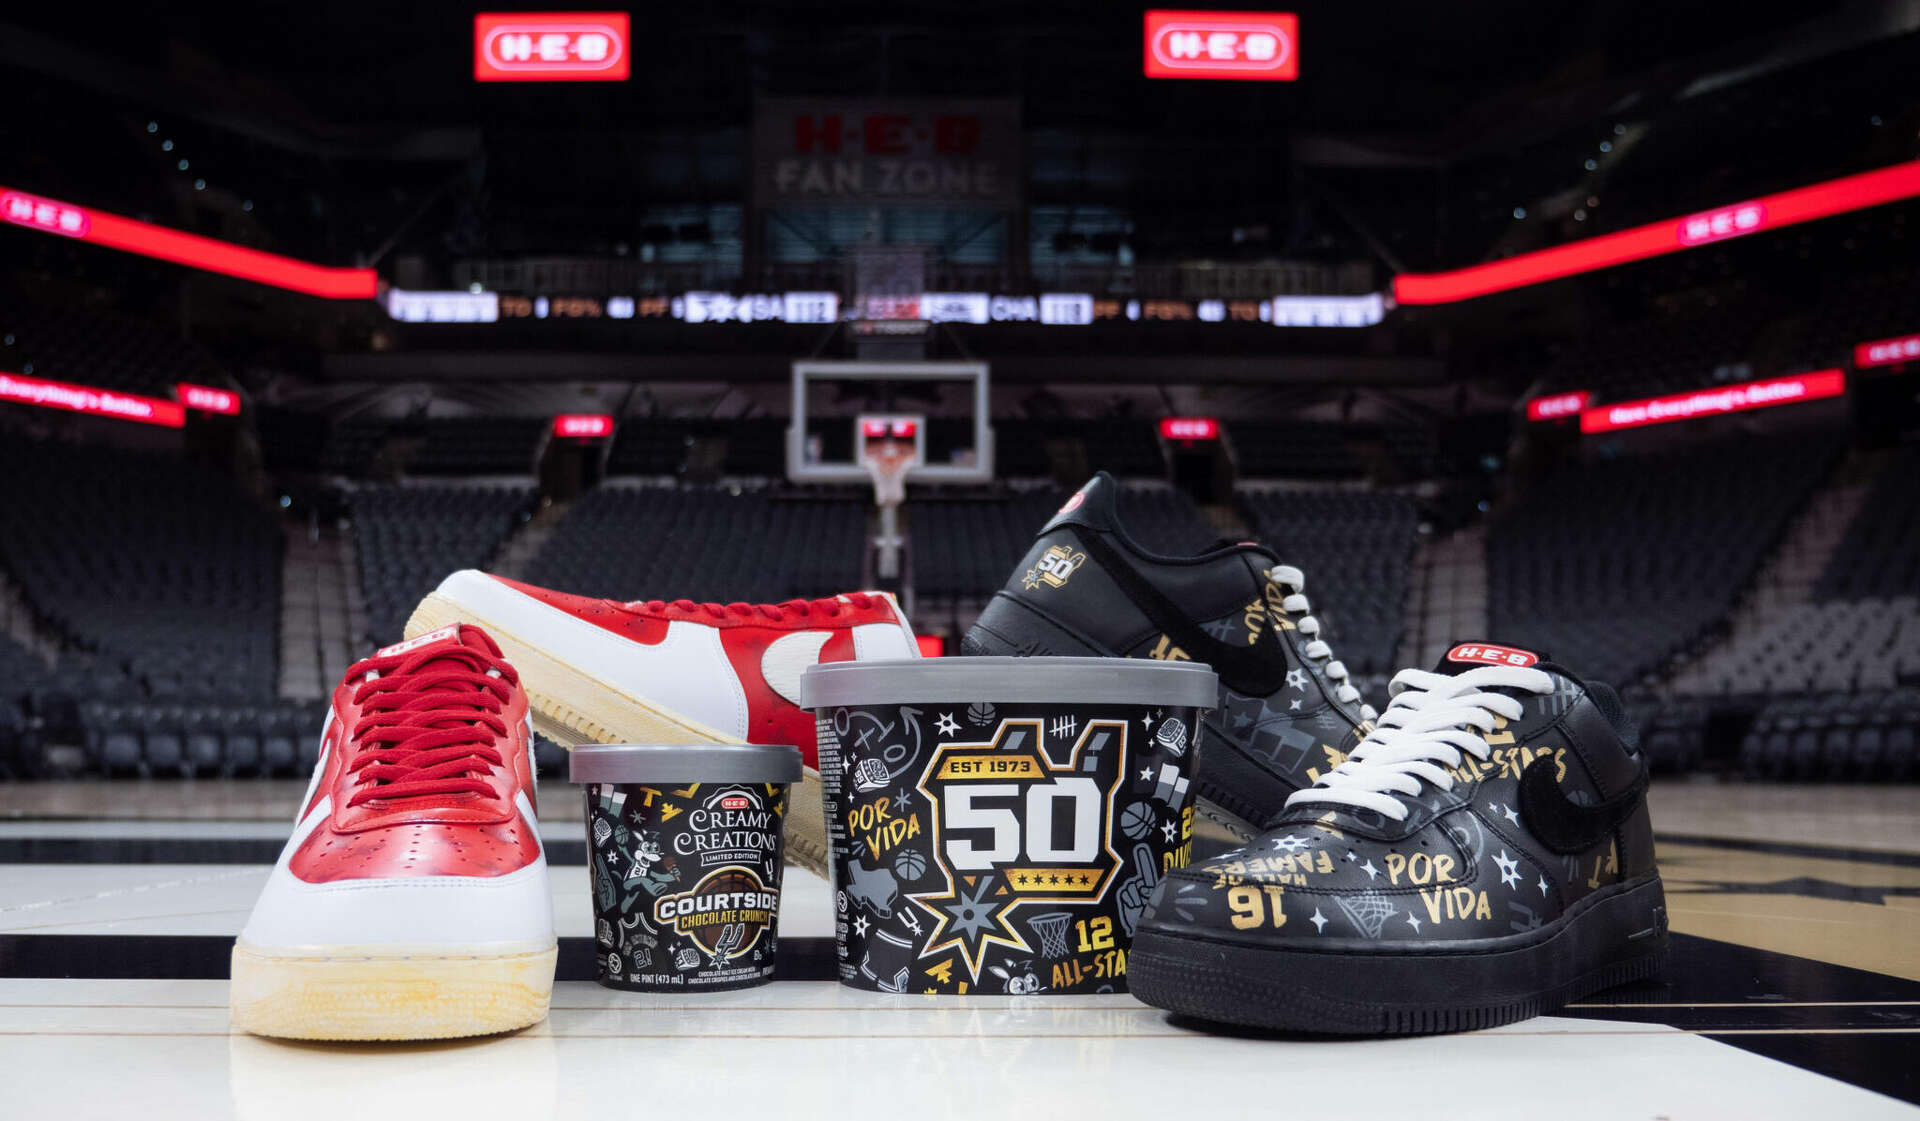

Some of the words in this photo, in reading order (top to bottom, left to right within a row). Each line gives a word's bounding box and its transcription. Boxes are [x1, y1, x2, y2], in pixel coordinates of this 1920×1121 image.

[775, 161, 862, 193] FAN
[879, 161, 998, 194] ZONE
[1039, 552, 1073, 580] 50
[950, 761, 983, 773] EST
[990, 760, 1031, 773] 1973
[689, 809, 772, 832] CREAMY
[848, 797, 892, 837] POR
[943, 777, 1102, 870] 50
[674, 831, 777, 855] CREATIONS
[866, 813, 920, 860] VIDA
[705, 854, 733, 862] LIMITED
[1384, 852, 1457, 886] POR
[660, 892, 777, 919] COURTSIDE
[681, 909, 737, 928] CHOCOLATE
[740, 909, 768, 922] CRUNCH
[1227, 885, 1287, 930] 16
[1418, 885, 1492, 924] VIDA
[1075, 915, 1115, 953] 12
[1052, 948, 1131, 989] ALL-STA
